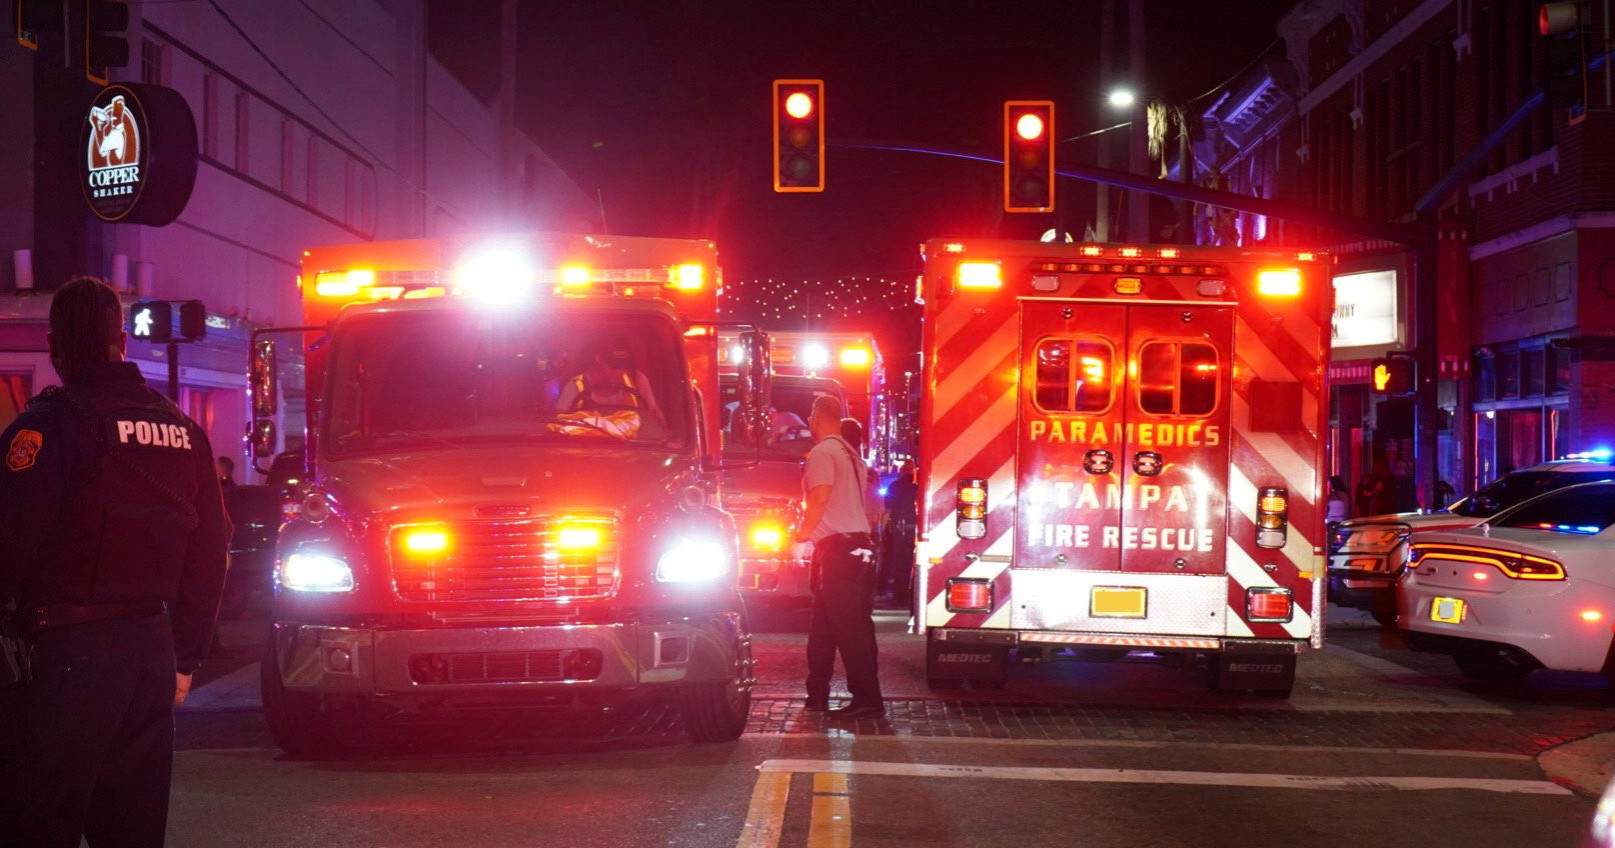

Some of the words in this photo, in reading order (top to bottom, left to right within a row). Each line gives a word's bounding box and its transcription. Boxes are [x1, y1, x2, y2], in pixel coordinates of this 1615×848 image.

[89, 166, 139, 187] COPPER
[94, 186, 133, 197] SHAKER
[117, 420, 192, 450] POLICE
[1030, 420, 1220, 446] PARAMEDICS
[1054, 482, 1189, 512] TAMPA
[1028, 523, 1090, 548] FIRE
[1103, 526, 1214, 552] RESCUE
[938, 653, 993, 663] MEDTEC
[1229, 663, 1284, 673] MEDTEC
